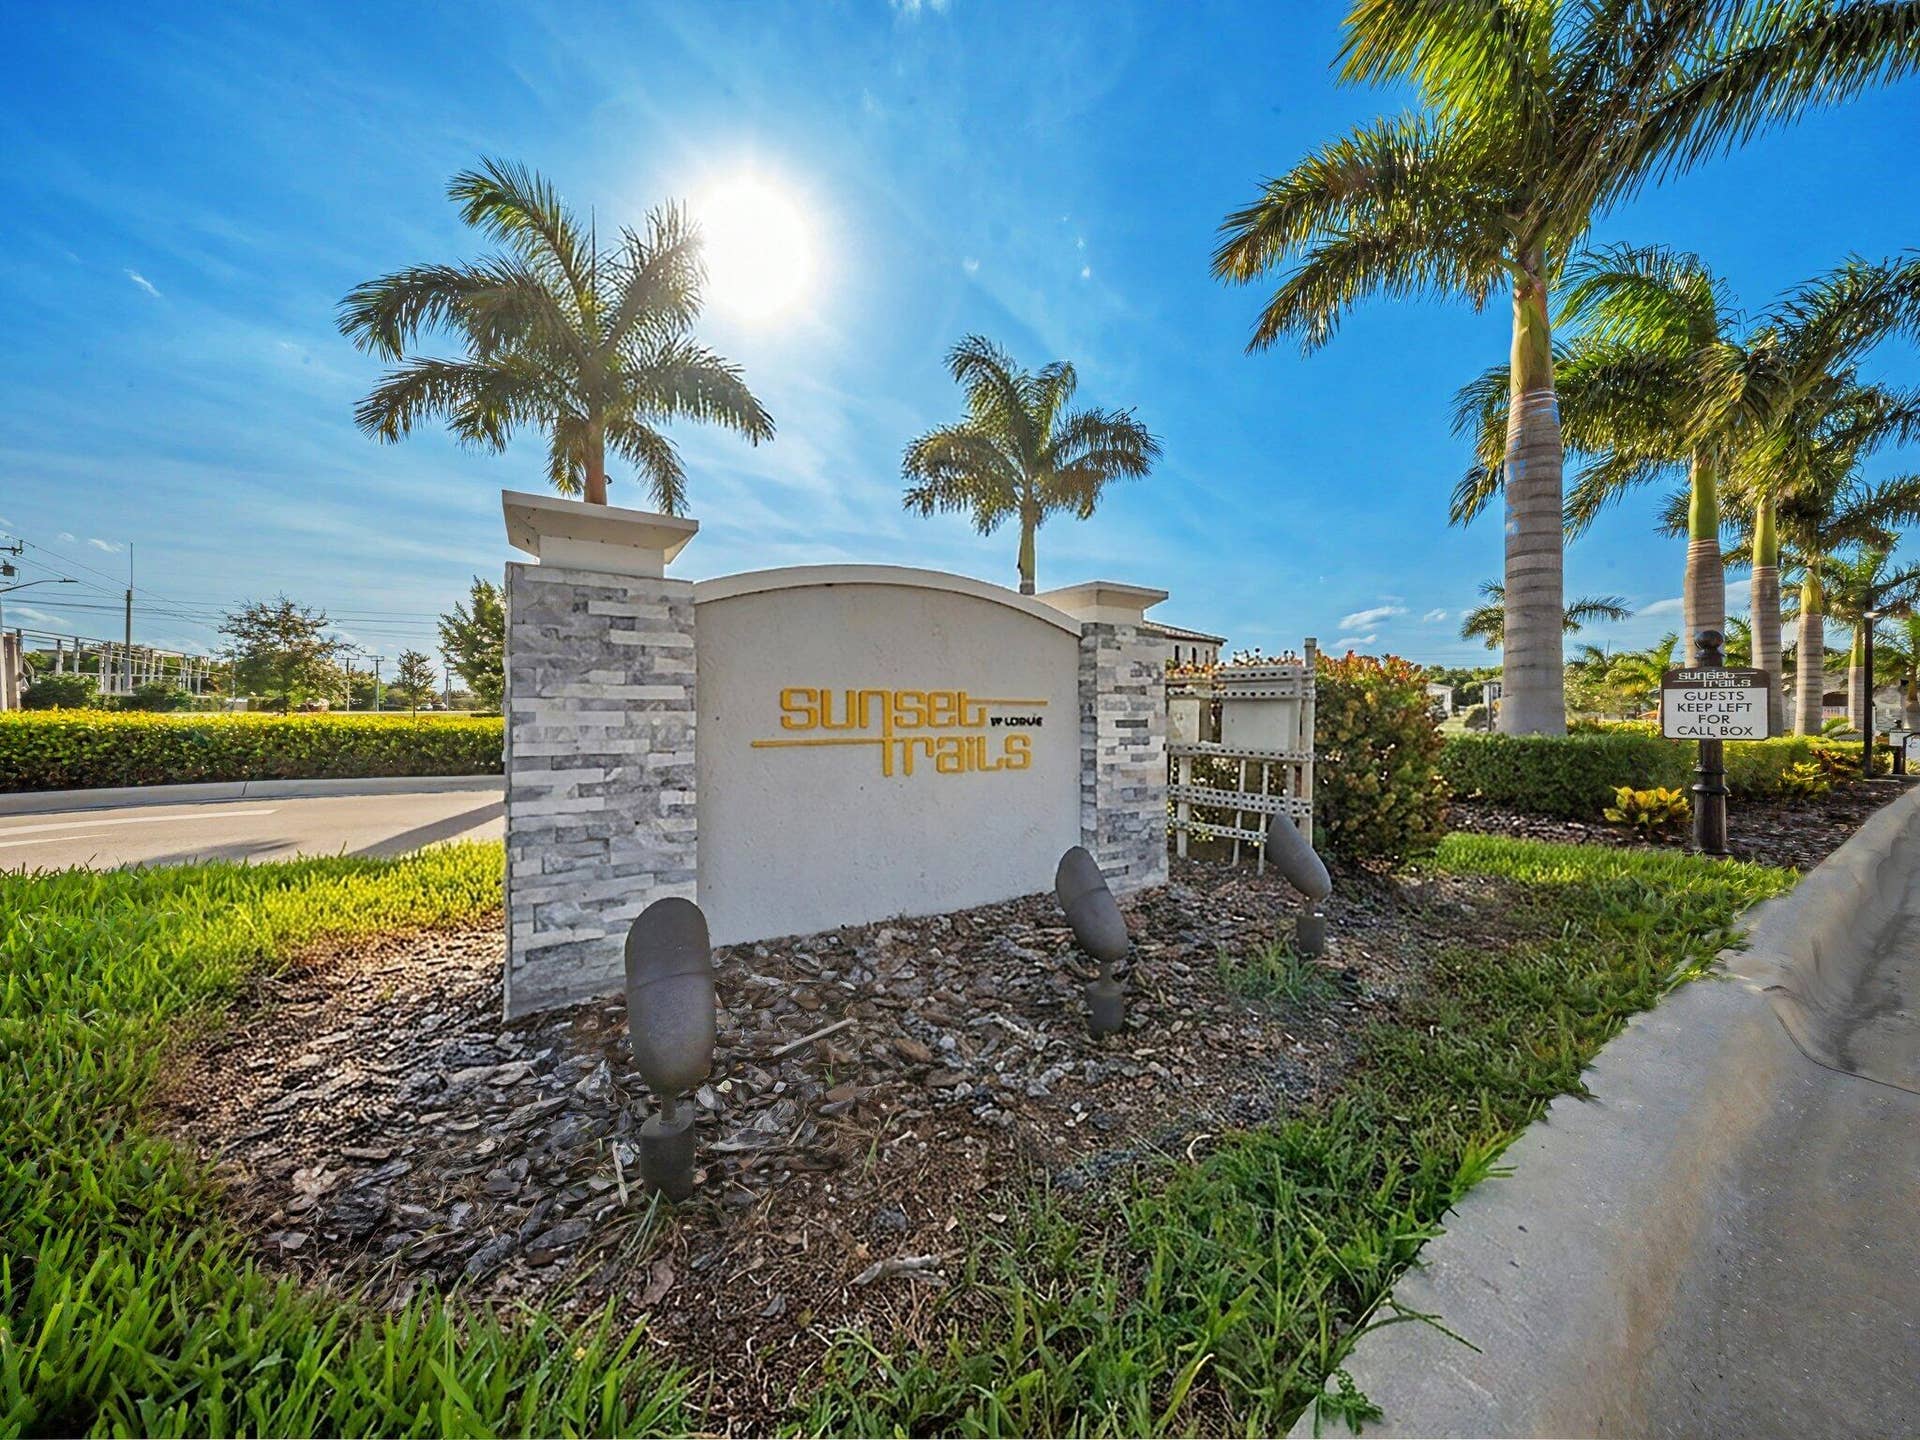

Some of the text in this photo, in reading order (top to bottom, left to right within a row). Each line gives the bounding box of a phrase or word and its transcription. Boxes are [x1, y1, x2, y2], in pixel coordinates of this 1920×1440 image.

[1684, 691, 1744, 701] GUESTS
[1677, 703, 1752, 712] KEEP LEFT
[1698, 714, 1730, 724] FOR
[1677, 726, 1753, 736] CALL BOX
